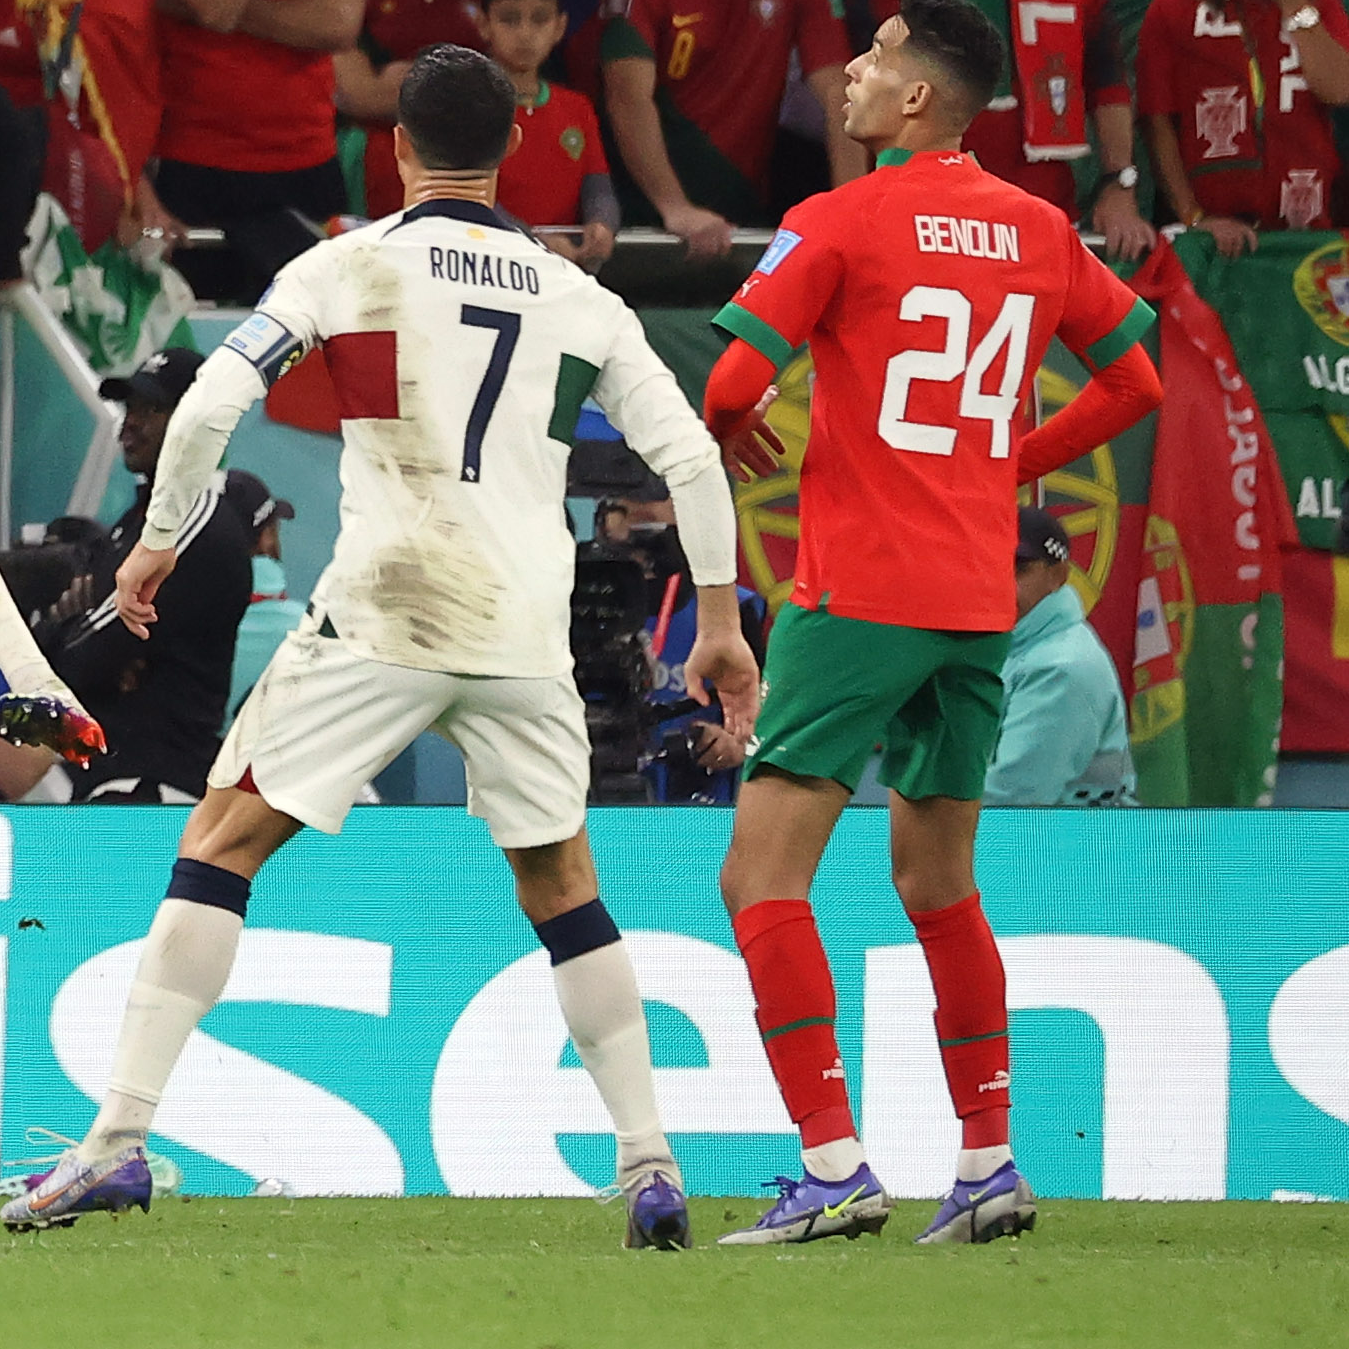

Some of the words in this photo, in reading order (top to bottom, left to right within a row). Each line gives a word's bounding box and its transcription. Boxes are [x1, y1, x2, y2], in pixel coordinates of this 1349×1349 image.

[429, 246, 539, 295] RONALDO
[913, 214, 1021, 263] BENOUN
[460, 303, 522, 483] 7
[877, 284, 1037, 459] 24
